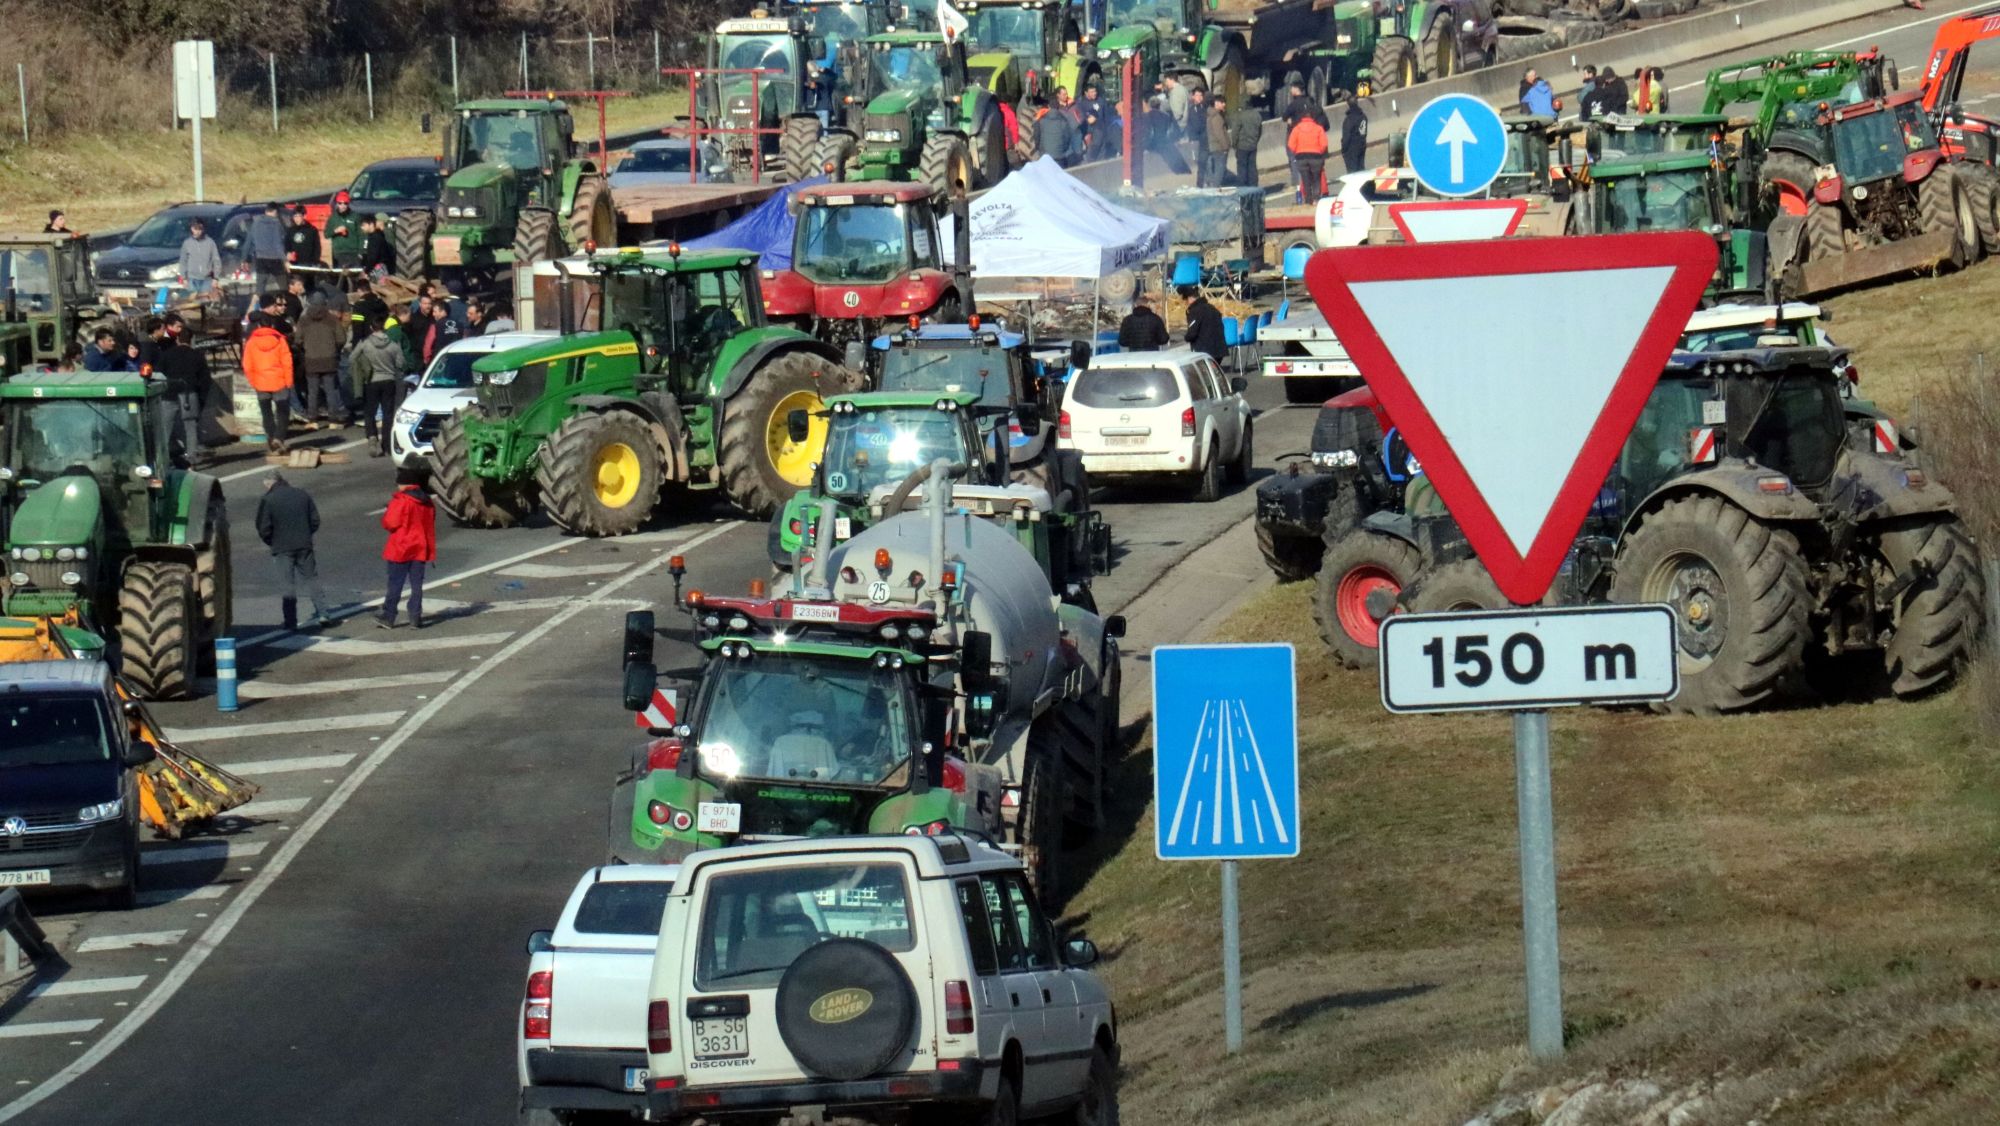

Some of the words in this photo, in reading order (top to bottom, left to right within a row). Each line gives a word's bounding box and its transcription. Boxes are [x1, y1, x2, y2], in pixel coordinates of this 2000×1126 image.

[970, 202, 1013, 221] REVOLTA
[846, 293, 857, 306] 40
[831, 475, 843, 489] 50
[873, 582, 886, 601] 25
[1423, 632, 1544, 688] 150
[1584, 643, 1637, 682] m
[0, 873, 23, 884] 778
[26, 871, 48, 882] MTL
[821, 993, 851, 1010] LAND
[826, 1000, 864, 1019] ROVER
[695, 1020, 706, 1036] B
[723, 1018, 744, 1033] SG
[701, 1035, 739, 1053] 3631
[690, 1058, 756, 1069] DISCOVERY
